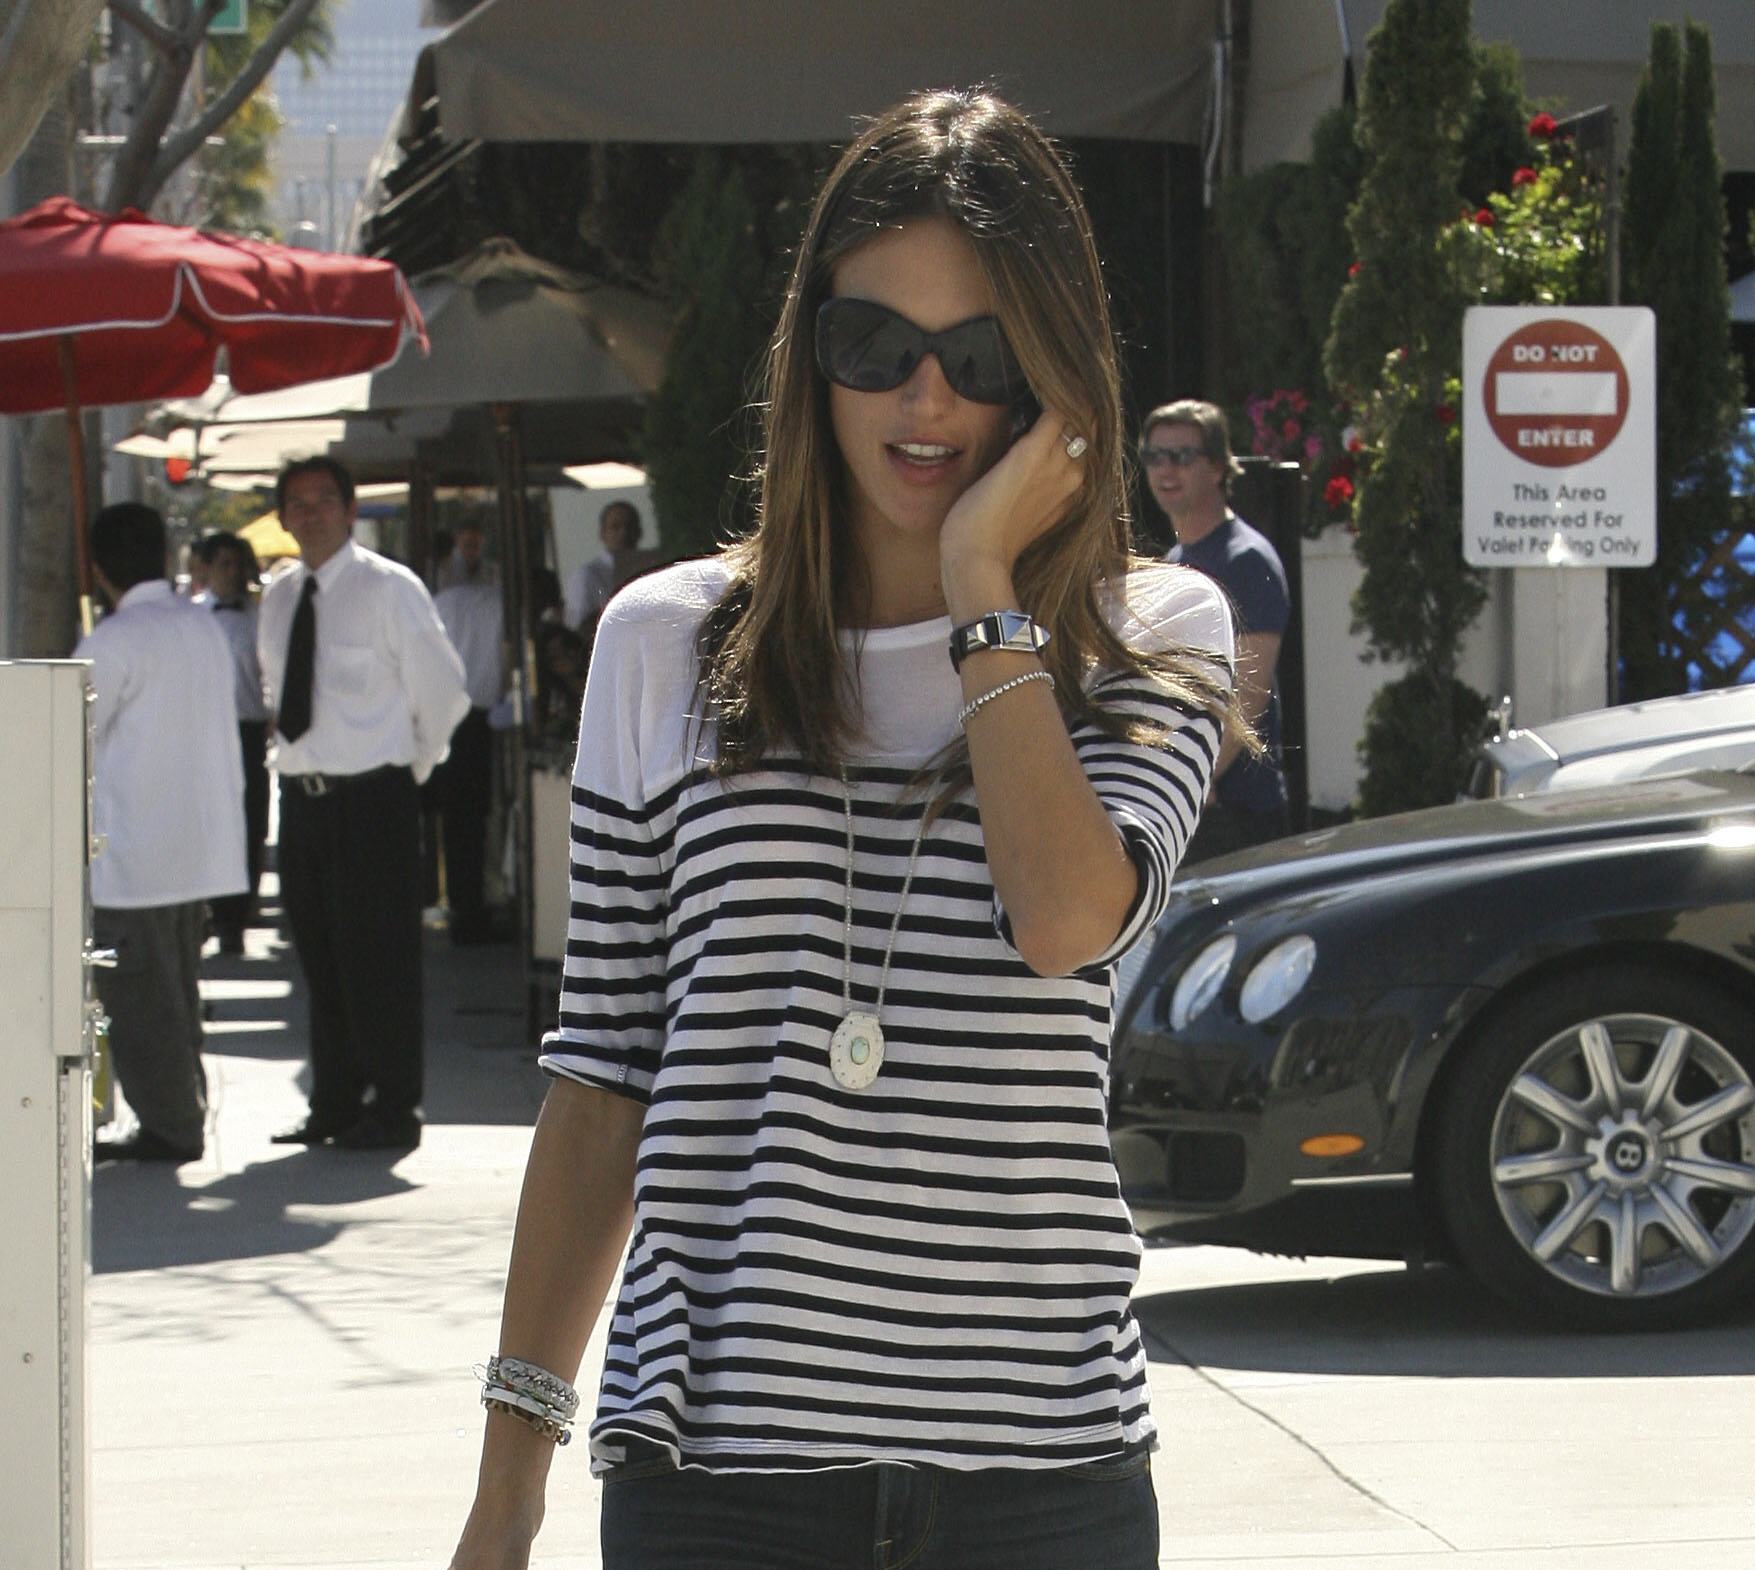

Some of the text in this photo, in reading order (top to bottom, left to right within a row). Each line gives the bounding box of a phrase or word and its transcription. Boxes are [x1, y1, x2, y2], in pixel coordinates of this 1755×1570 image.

[1513, 344, 1598, 363] DO NOT
[1518, 428, 1594, 447] ENTER
[1513, 484, 1607, 501] This Area
[1494, 511, 1624, 528] Reserved For
[1478, 536, 1640, 557] Valet Paing Only
